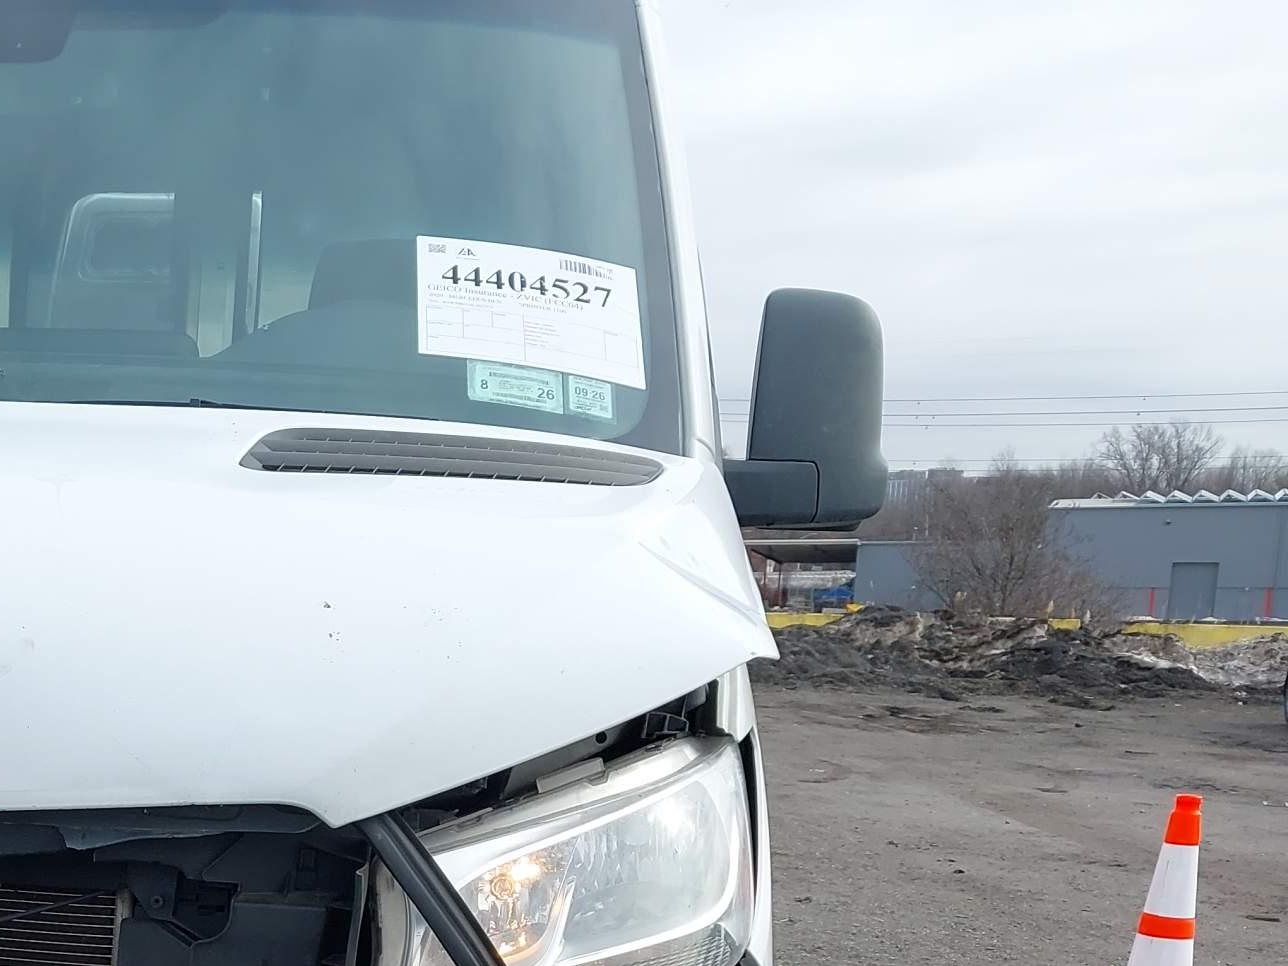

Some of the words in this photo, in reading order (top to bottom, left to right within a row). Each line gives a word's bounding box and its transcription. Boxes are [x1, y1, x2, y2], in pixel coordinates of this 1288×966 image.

[441, 264, 613, 308] 44404527
[480, 379, 489, 390] 8
[537, 387, 555, 401] 26
